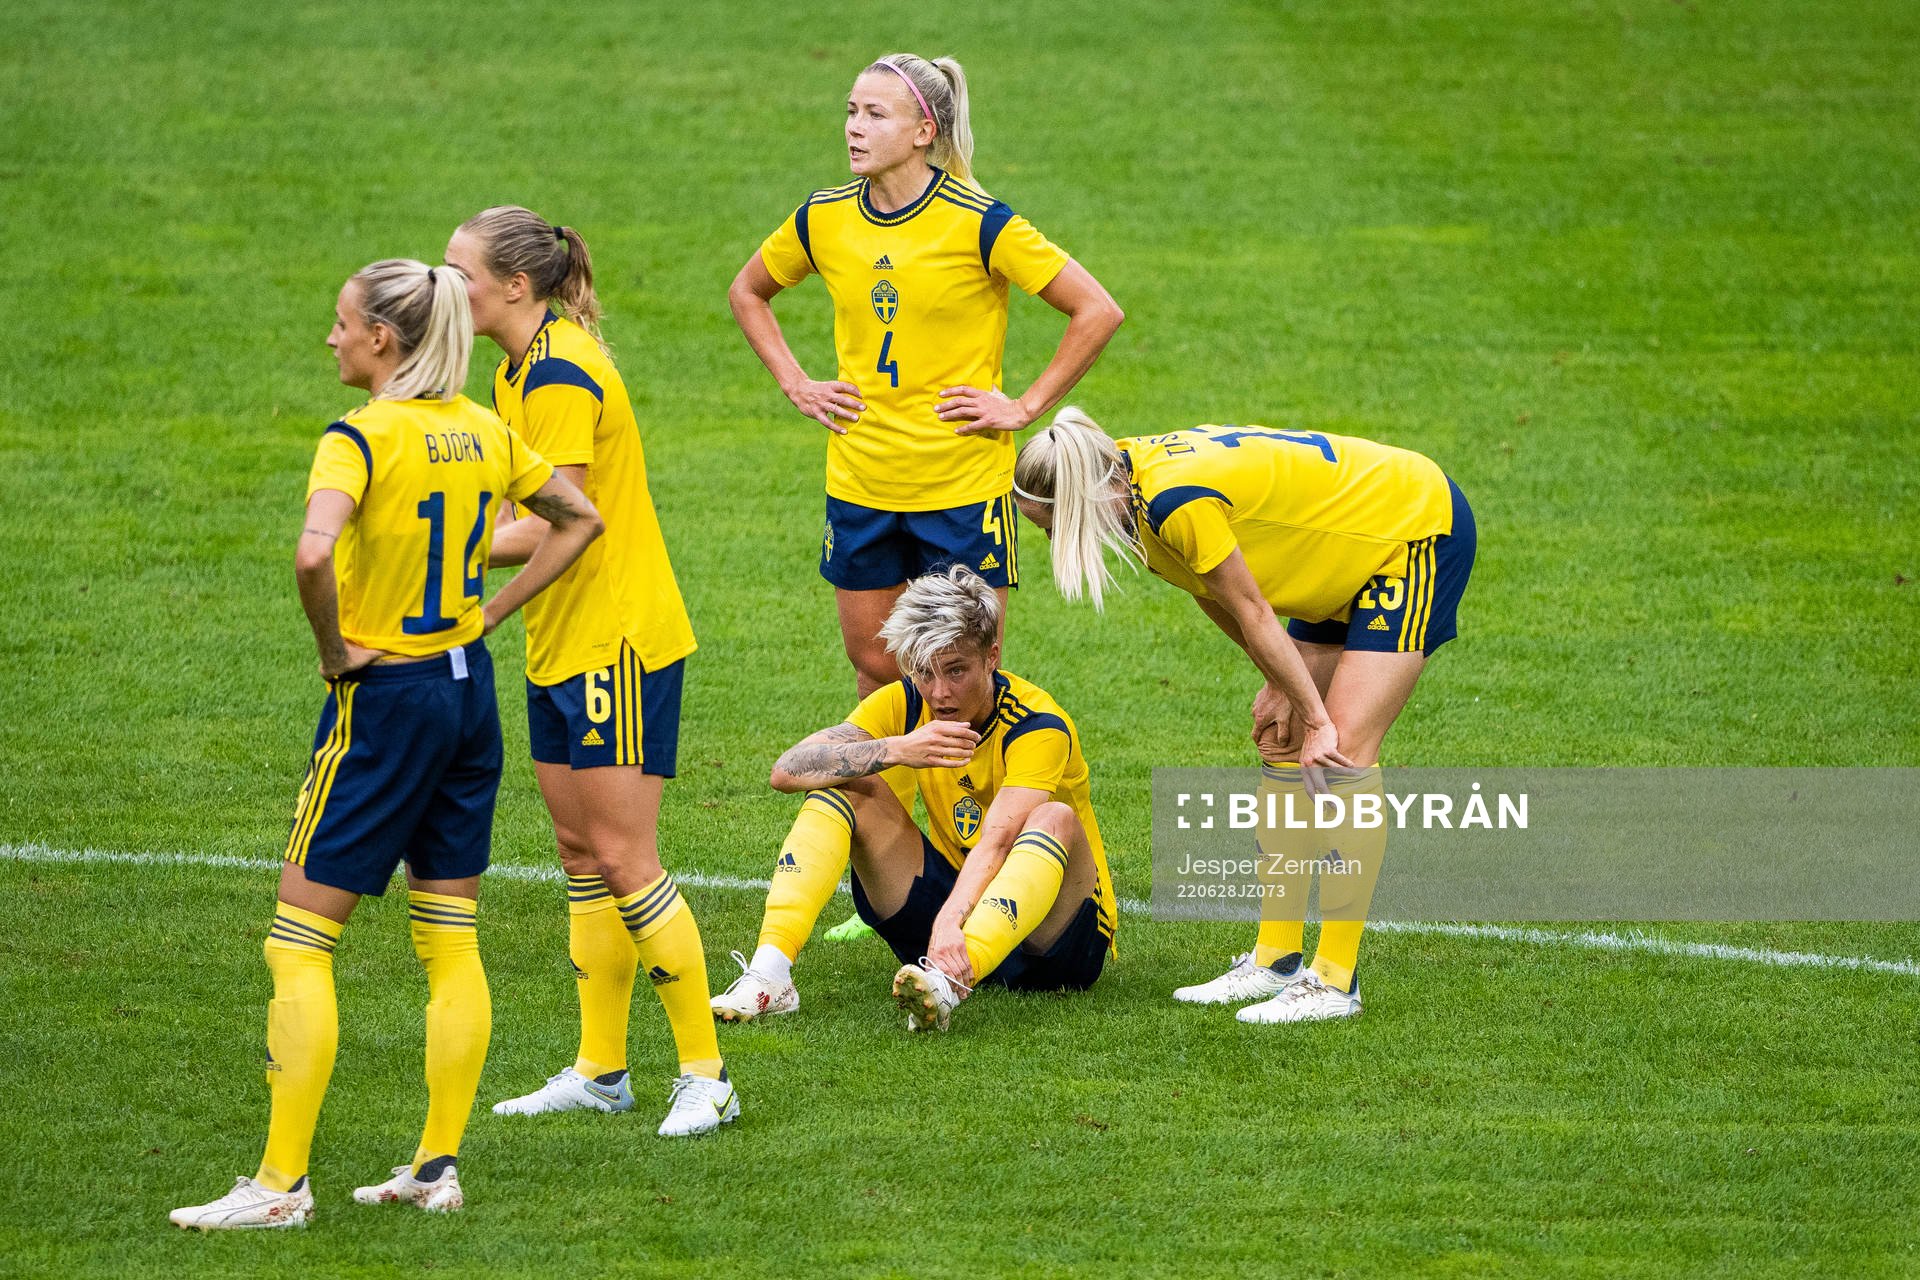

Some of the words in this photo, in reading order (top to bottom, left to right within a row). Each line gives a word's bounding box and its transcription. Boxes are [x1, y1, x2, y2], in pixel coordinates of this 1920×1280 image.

[877, 331, 899, 388] 4
[425, 428, 484, 464] BJÖRN
[982, 498, 1002, 546] 4
[402, 490, 493, 635] 14
[585, 667, 611, 724] 6
